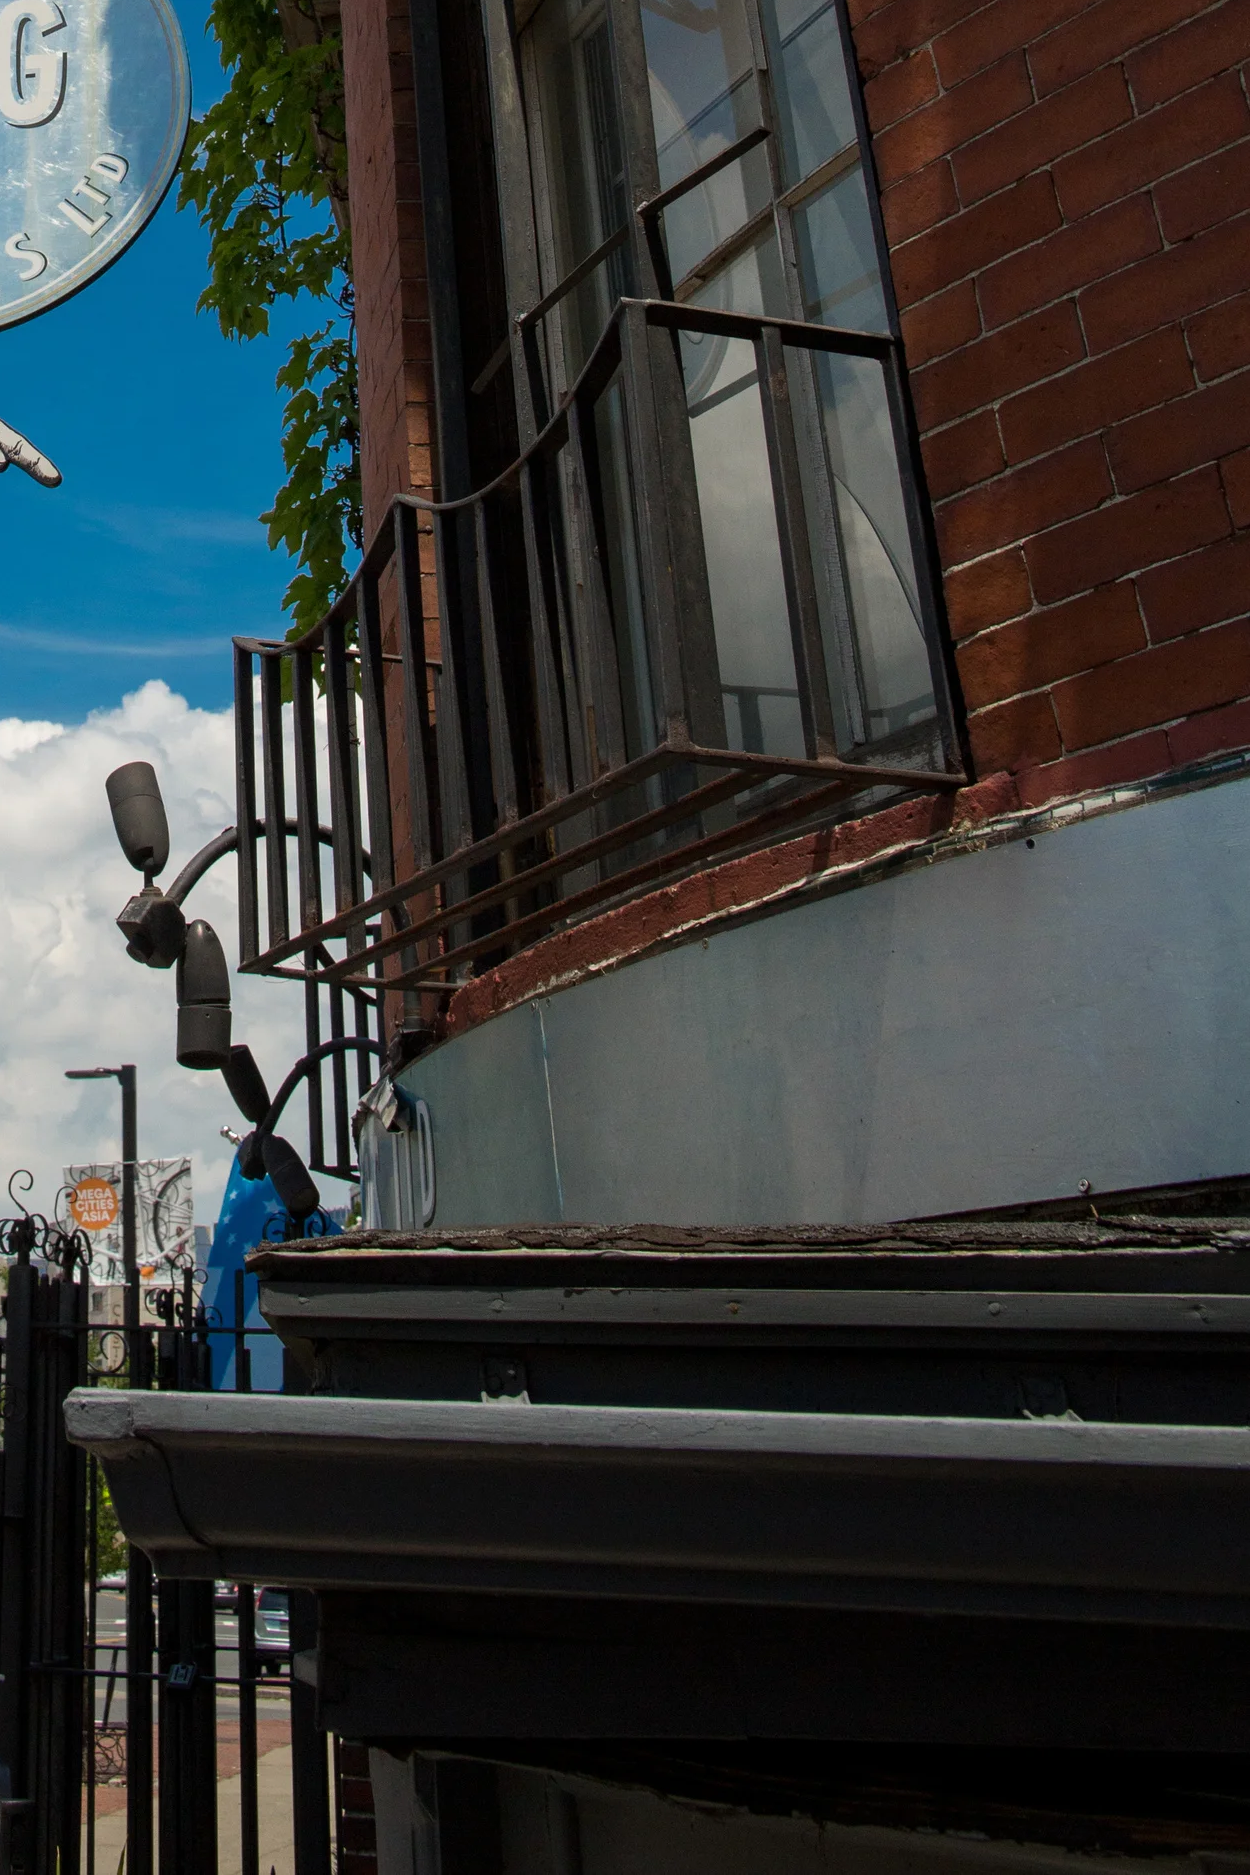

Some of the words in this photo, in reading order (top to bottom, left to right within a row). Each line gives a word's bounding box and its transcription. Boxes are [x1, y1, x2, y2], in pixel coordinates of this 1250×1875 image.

[58, 153, 130, 237] LTD
[76, 1187, 112, 1200] MEGA
[75, 1198, 114, 1211] CITIES
[81, 1210, 110, 1222] ASIA
